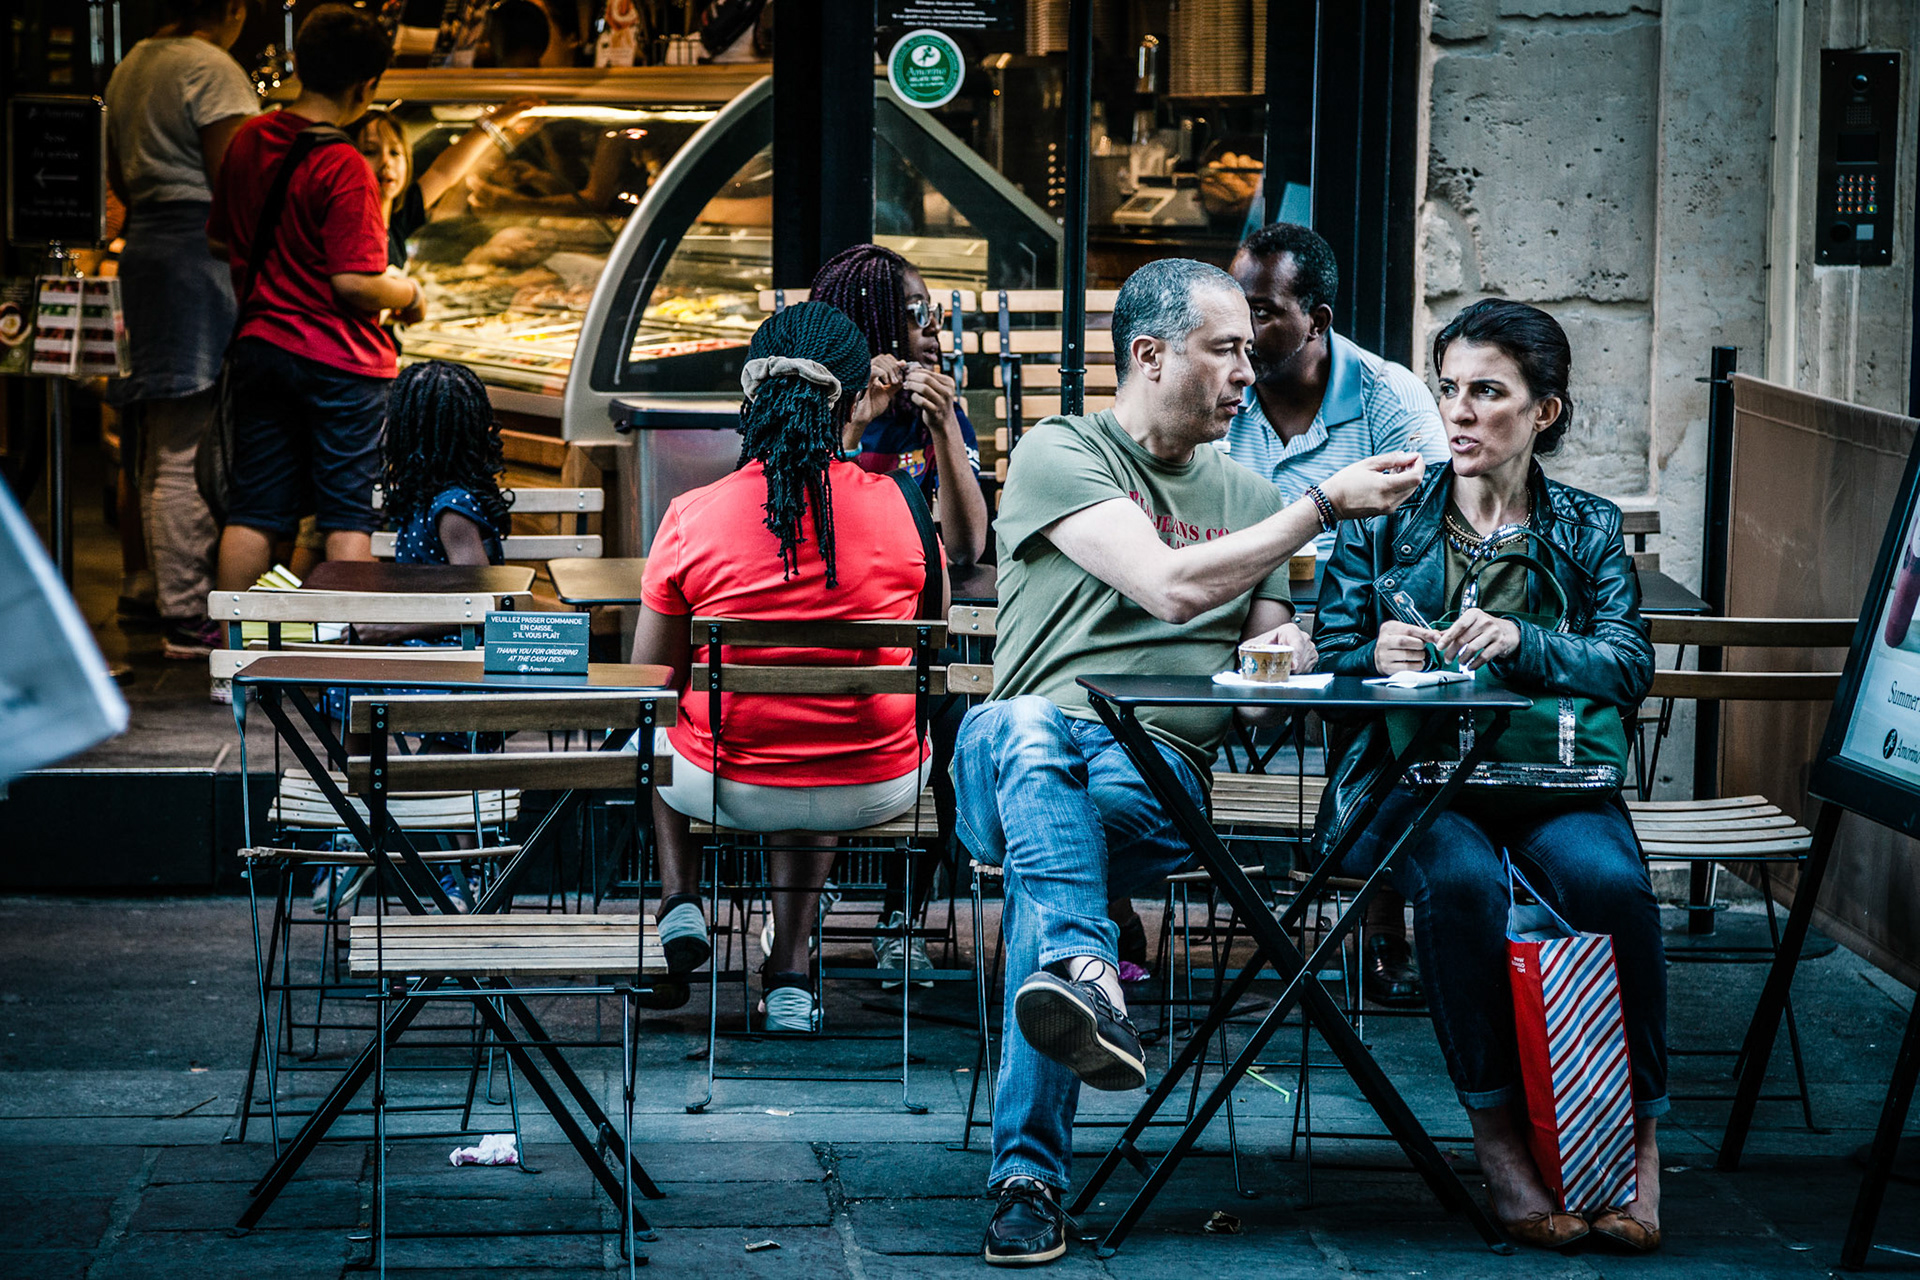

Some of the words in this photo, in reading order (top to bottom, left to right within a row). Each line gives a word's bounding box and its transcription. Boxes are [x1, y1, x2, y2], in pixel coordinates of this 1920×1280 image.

[1154, 515, 1199, 541] JEANS
[521, 616, 545, 624] PASSER
[546, 617, 583, 625] COMMANDE
[542, 631, 560, 639] PLAÎT
[545, 648, 579, 656] ORDERING
[1888, 680, 1920, 711] Summer
